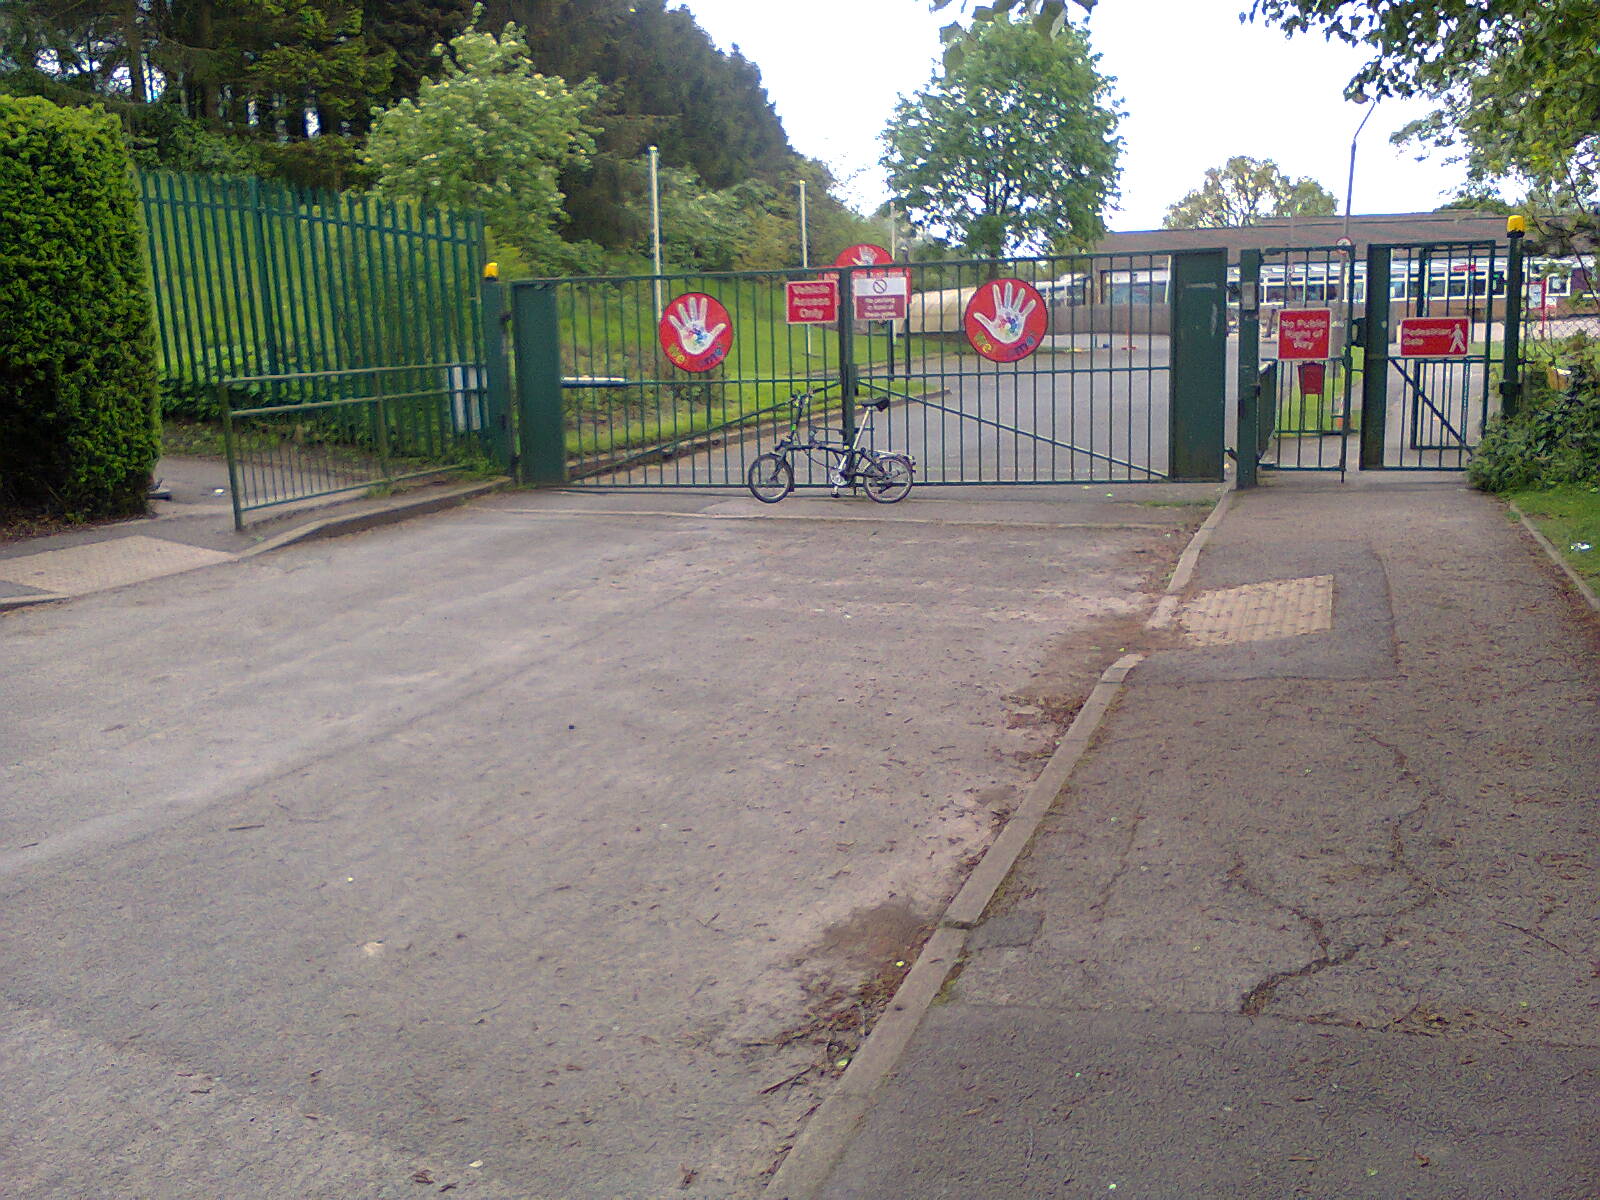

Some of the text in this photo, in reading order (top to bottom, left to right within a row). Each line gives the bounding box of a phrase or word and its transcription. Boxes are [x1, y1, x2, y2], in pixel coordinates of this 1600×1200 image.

[799, 307, 825, 319] Only
[1281, 318, 1327, 328] No Public
[1285, 328, 1324, 340] Right of
[1293, 341, 1314, 350] Way
